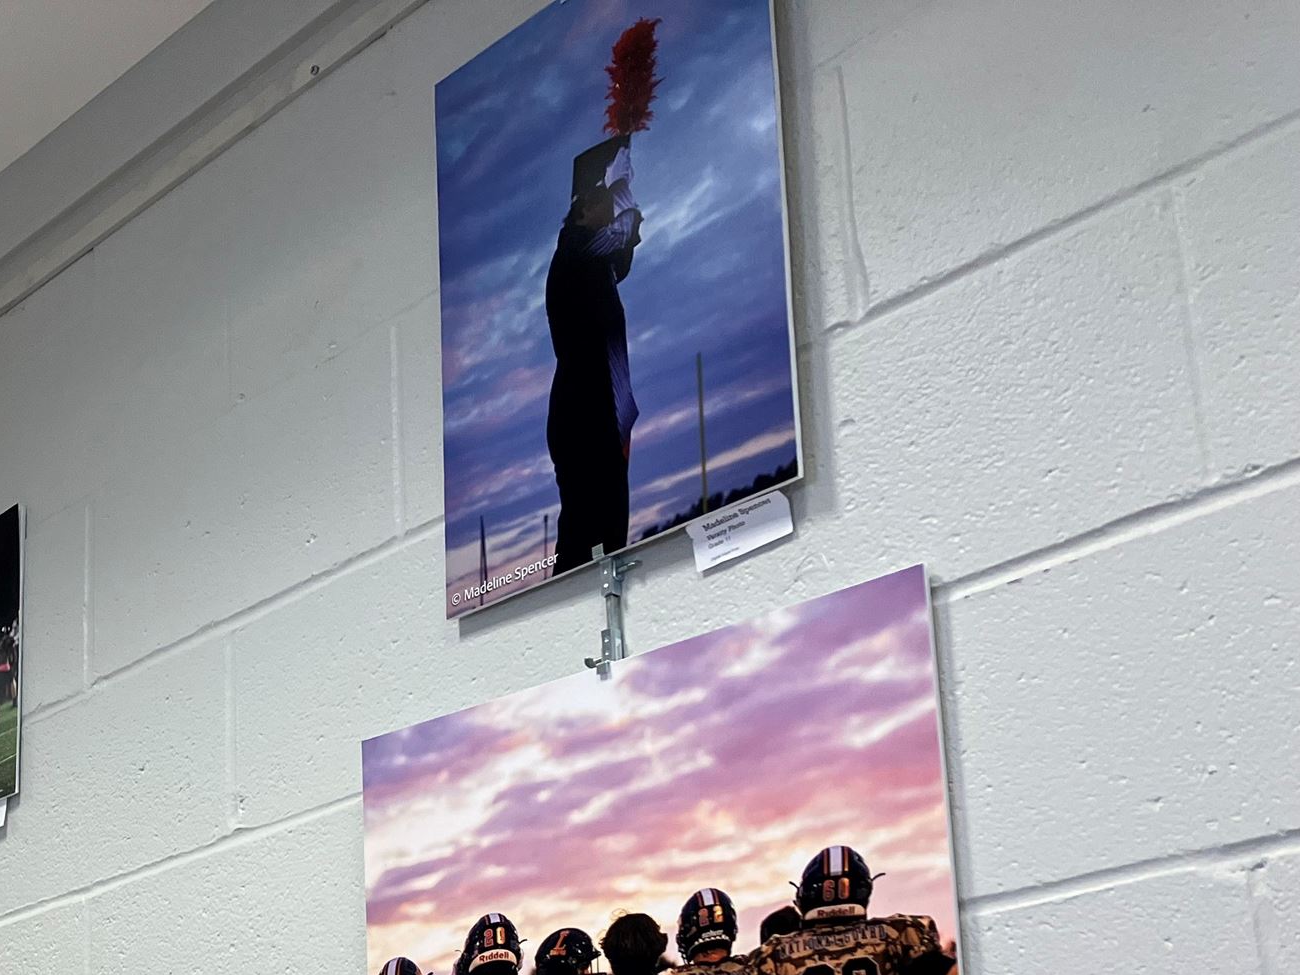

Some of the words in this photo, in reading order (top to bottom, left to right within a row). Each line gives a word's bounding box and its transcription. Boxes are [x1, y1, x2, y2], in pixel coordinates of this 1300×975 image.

[464, 576, 512, 601] Madeline
[514, 553, 559, 581] Spencer
[478, 951, 509, 963] Riddell
